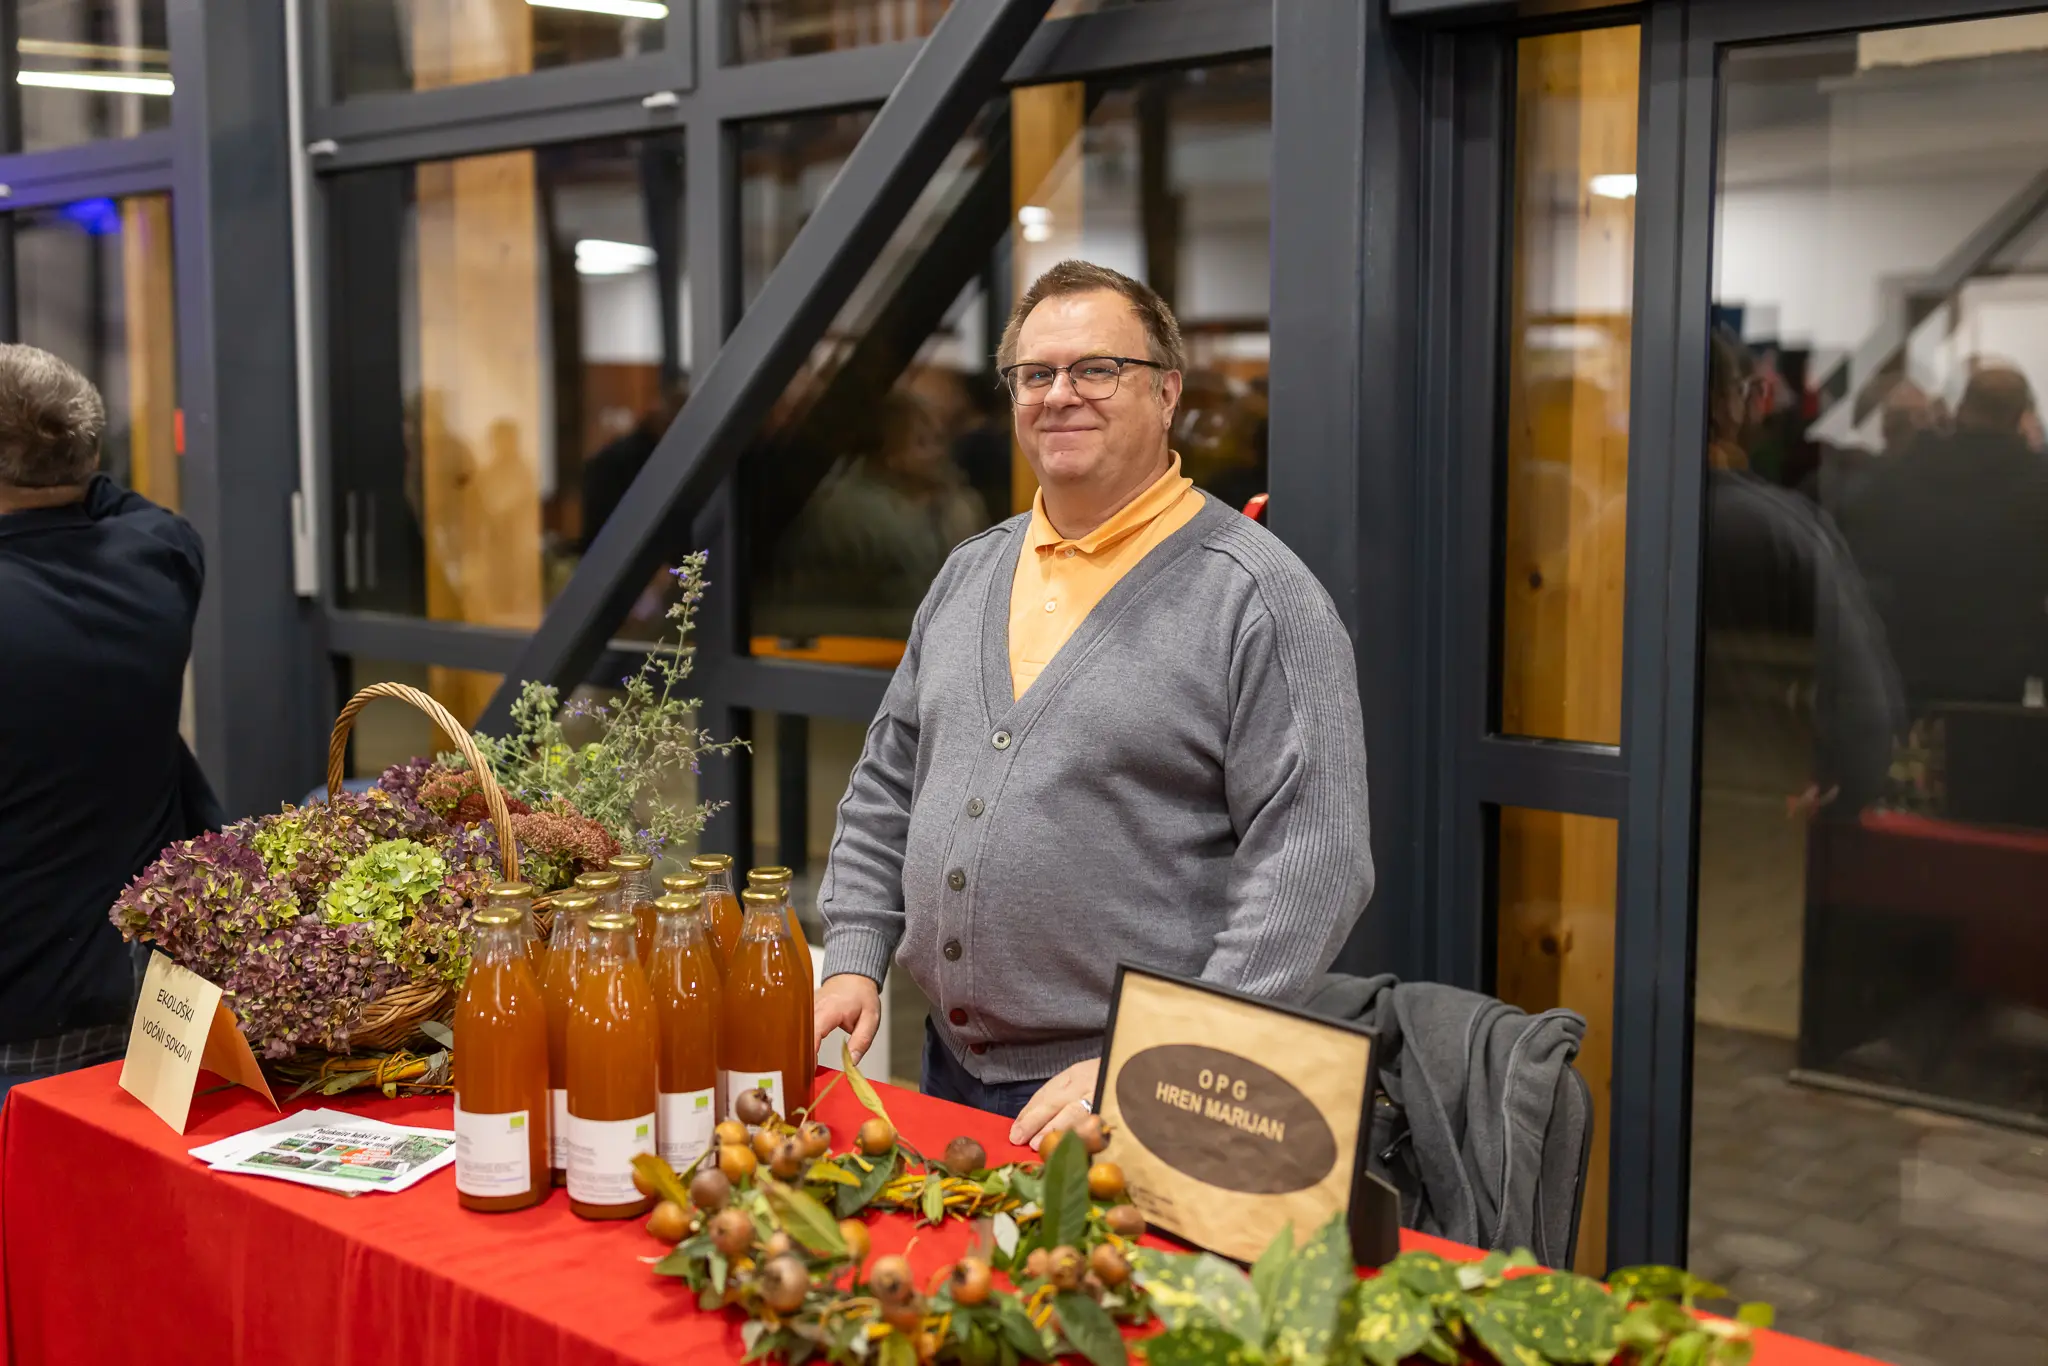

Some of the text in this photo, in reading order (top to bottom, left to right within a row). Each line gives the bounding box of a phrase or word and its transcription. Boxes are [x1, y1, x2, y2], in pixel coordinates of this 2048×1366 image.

[157, 988, 195, 1023] EKOLOŠKI
[164, 1034, 193, 1063] SOKOVI
[1155, 1080, 1286, 1143] HREN MARIJAN
